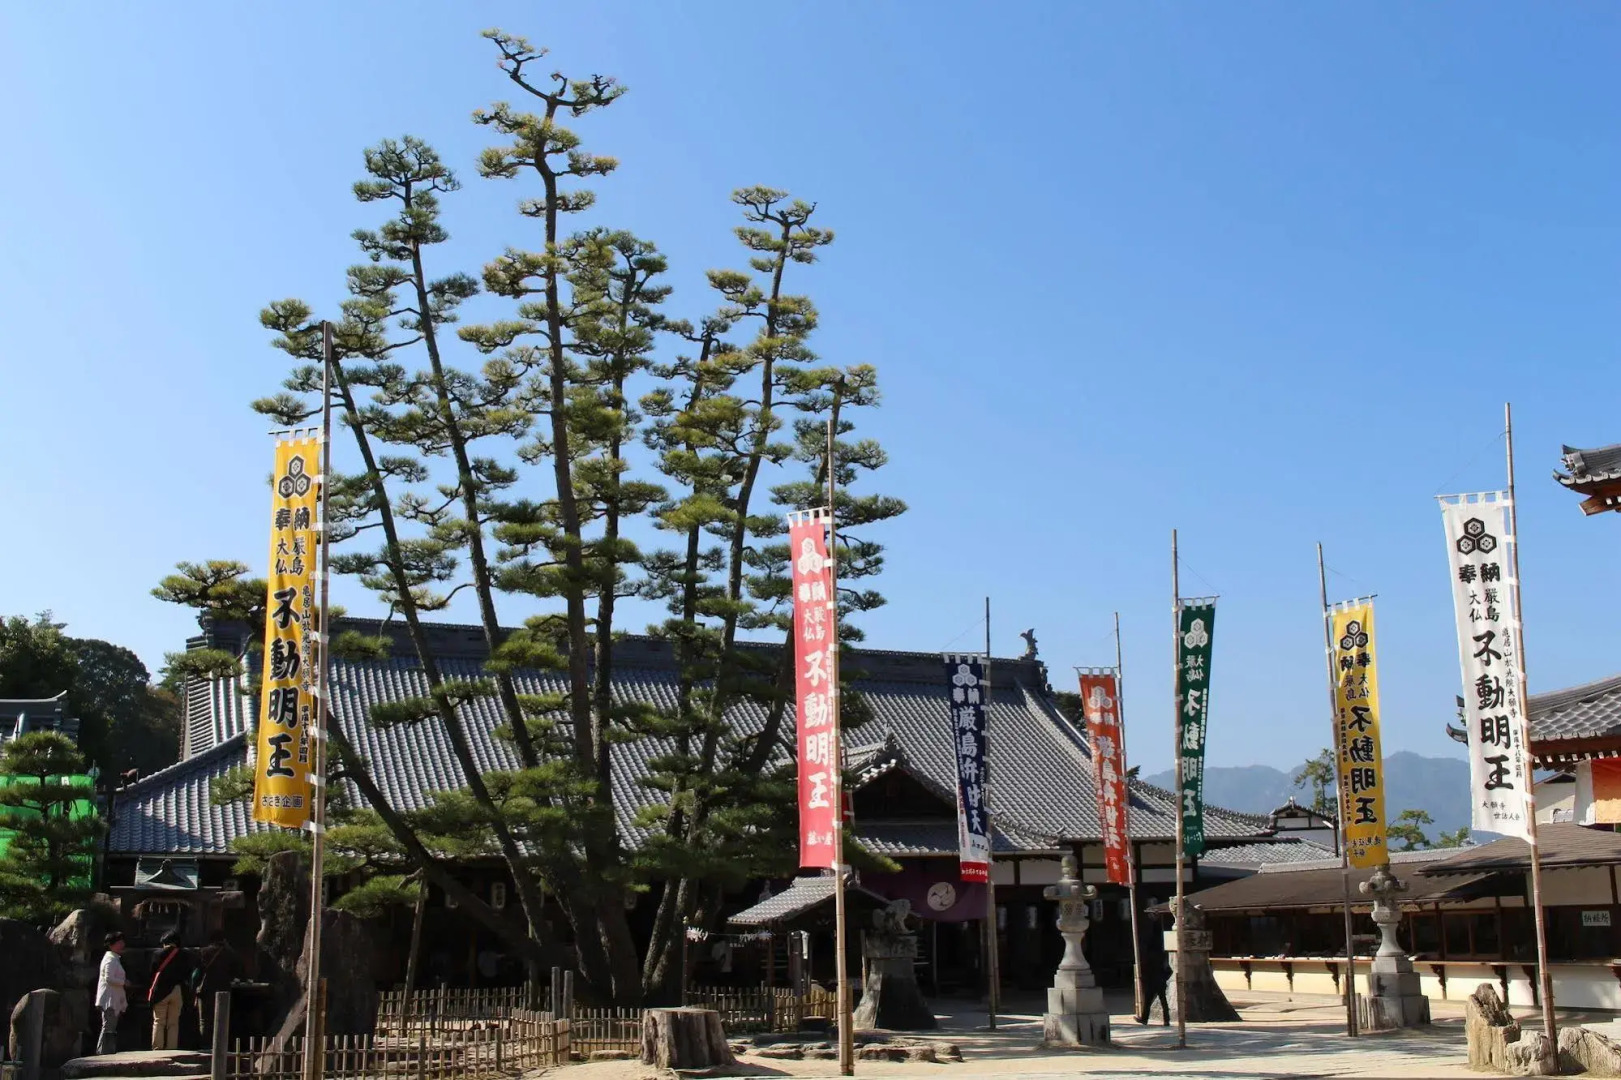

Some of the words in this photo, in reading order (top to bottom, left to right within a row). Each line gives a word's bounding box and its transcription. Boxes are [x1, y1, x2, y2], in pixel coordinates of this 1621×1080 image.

[275, 506, 311, 531] 奉納
[275, 538, 290, 575] 大仏
[1458, 562, 1500, 584] 奉納
[799, 581, 826, 603] 奉納
[1469, 590, 1483, 623] 大仏
[803, 608, 815, 642] 大仏
[266, 586, 301, 778] 不動明王
[1473, 630, 1514, 791] 不動明王
[804, 650, 830, 810] 不動明王
